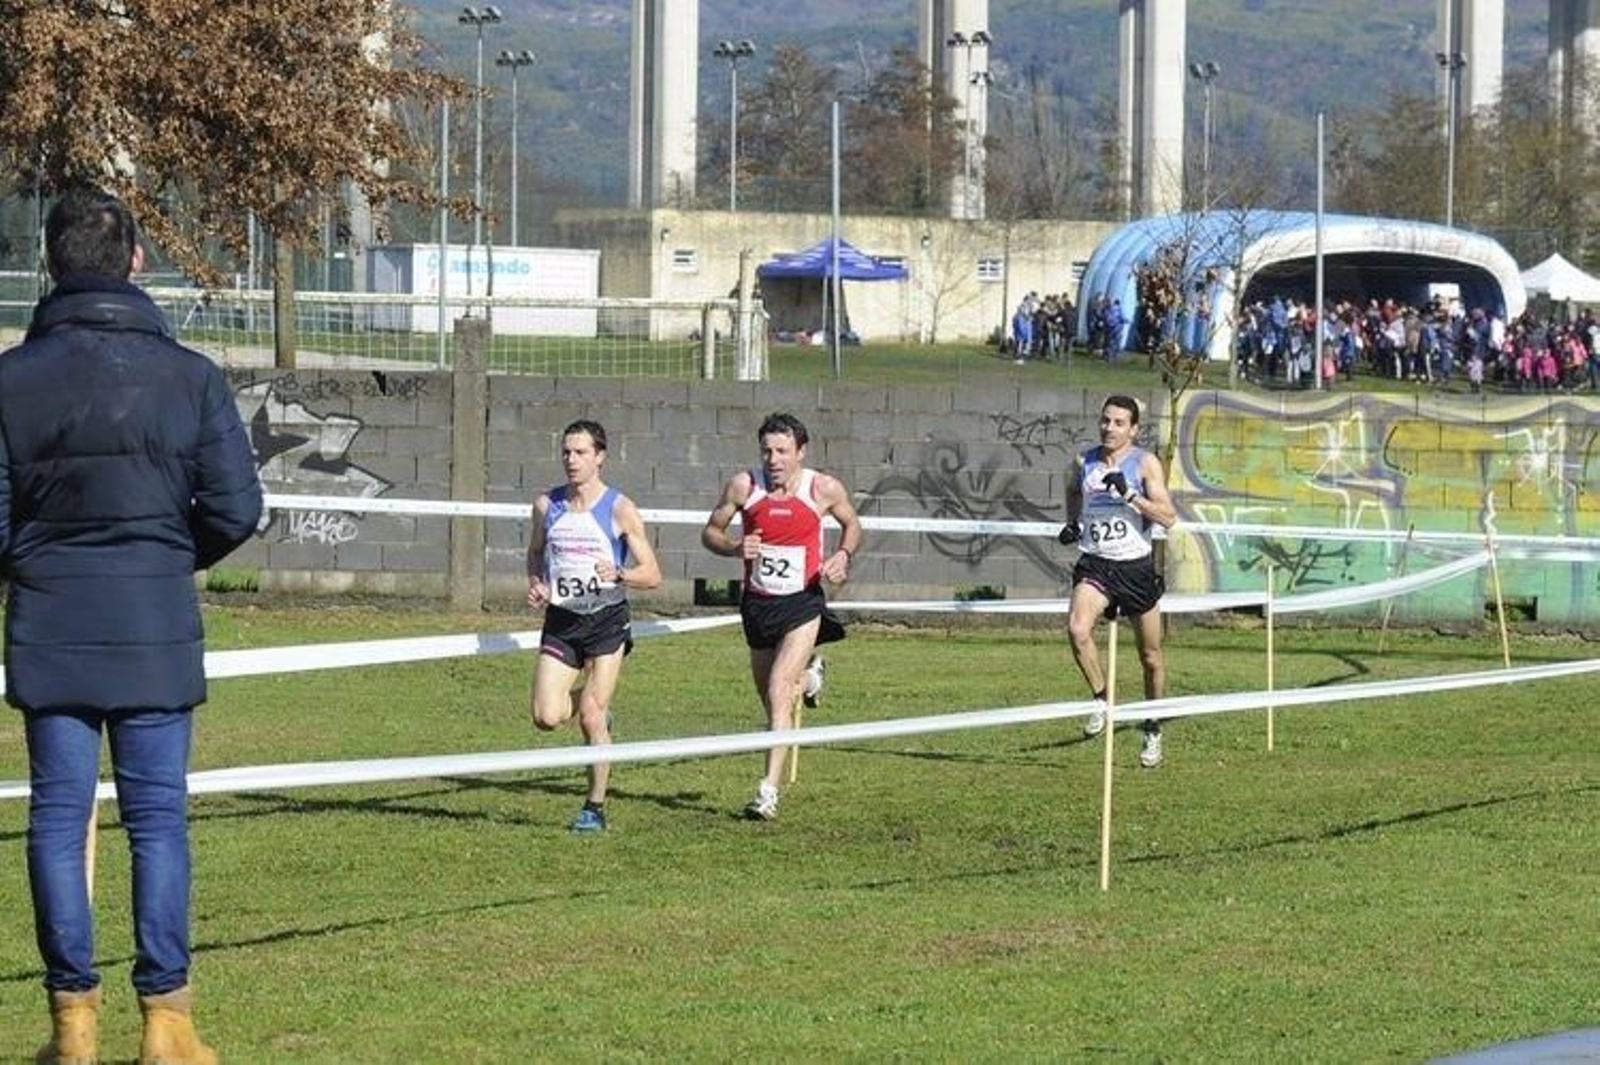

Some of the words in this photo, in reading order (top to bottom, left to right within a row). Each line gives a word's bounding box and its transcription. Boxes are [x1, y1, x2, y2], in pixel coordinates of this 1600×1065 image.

[1089, 520, 1128, 542] 629
[761, 557, 790, 579] 52
[557, 577, 602, 598] 634
